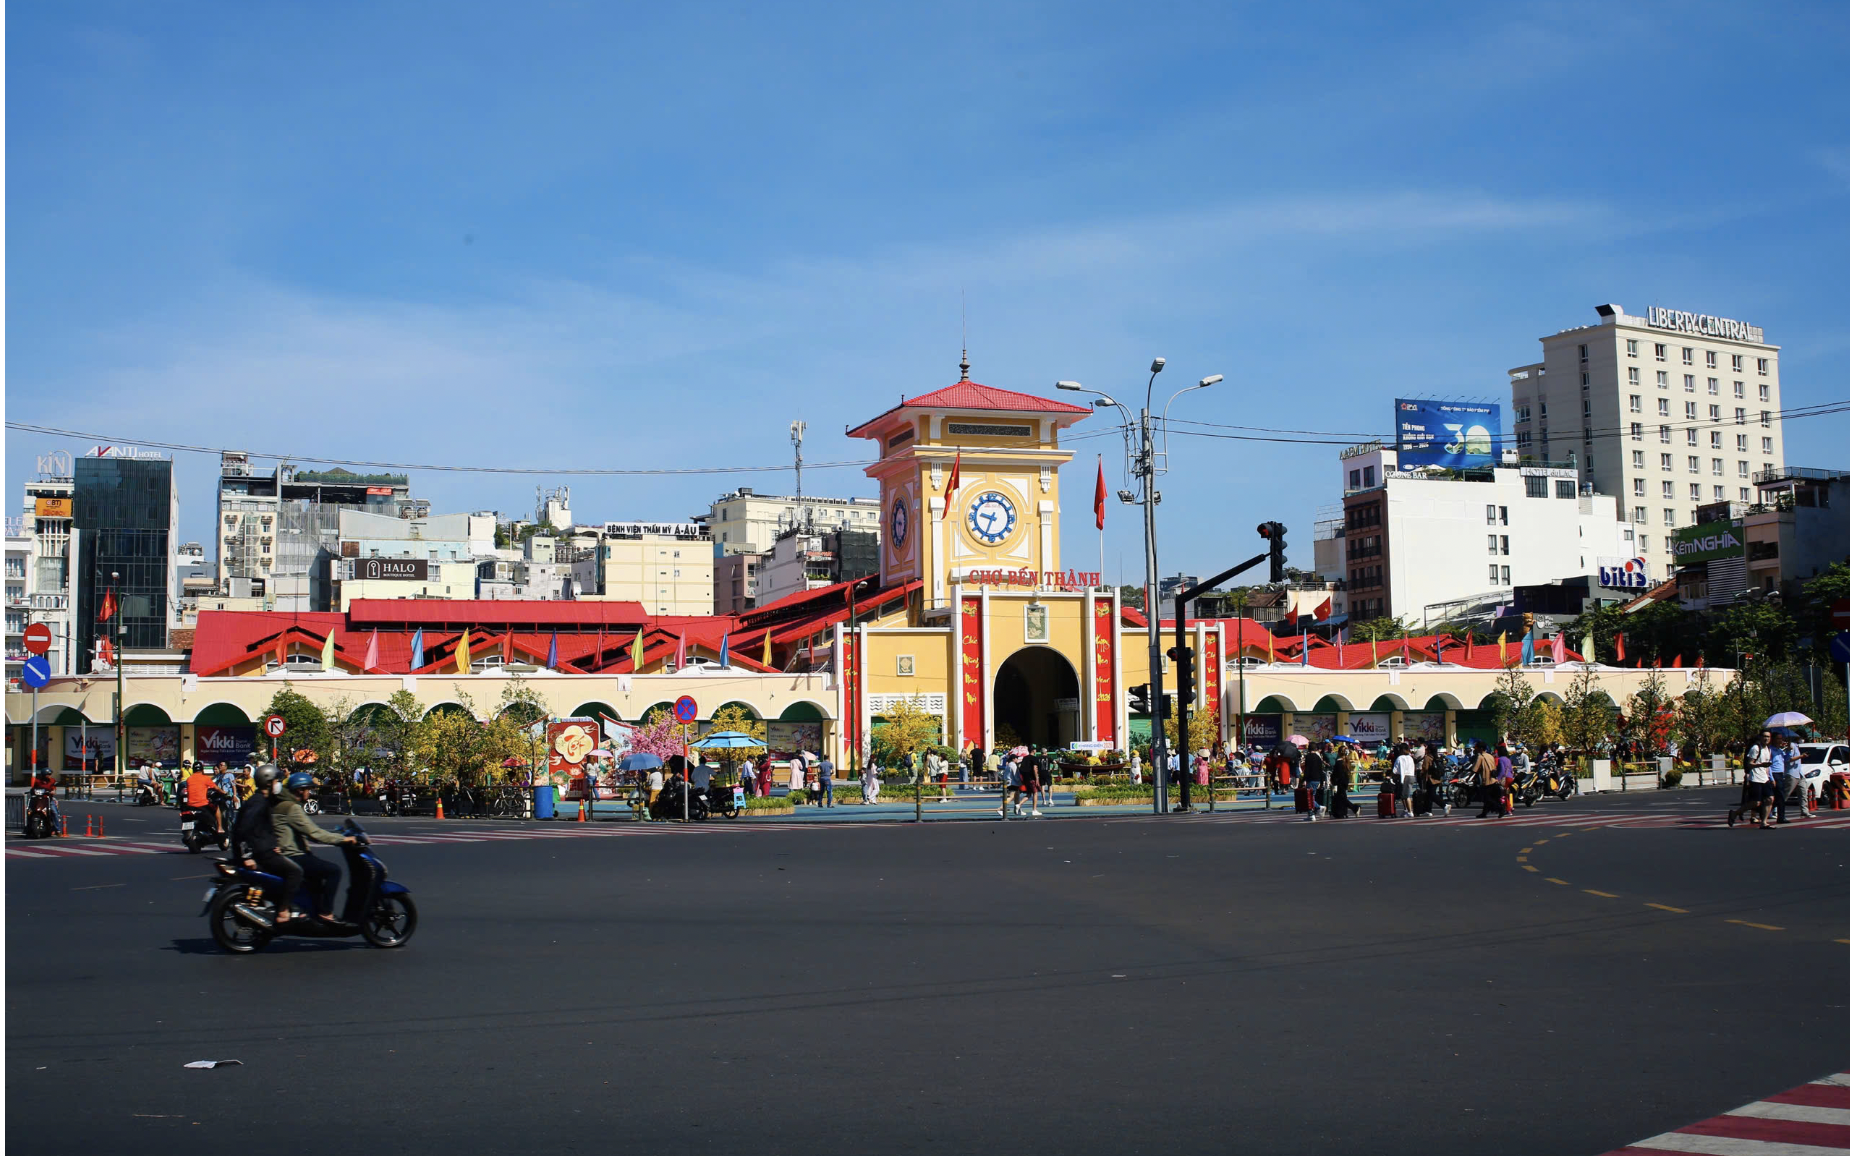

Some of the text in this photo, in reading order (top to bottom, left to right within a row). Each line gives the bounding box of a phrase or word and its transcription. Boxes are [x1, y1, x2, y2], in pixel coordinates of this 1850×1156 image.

[1648, 306, 1754, 341] LIBERTY CENTRAL
[383, 563, 416, 573] HALO
[969, 566, 1100, 587] CHỢ BẾN THÀNH
[1350, 718, 1374, 733] Vikki
[201, 730, 235, 749] Vikki
